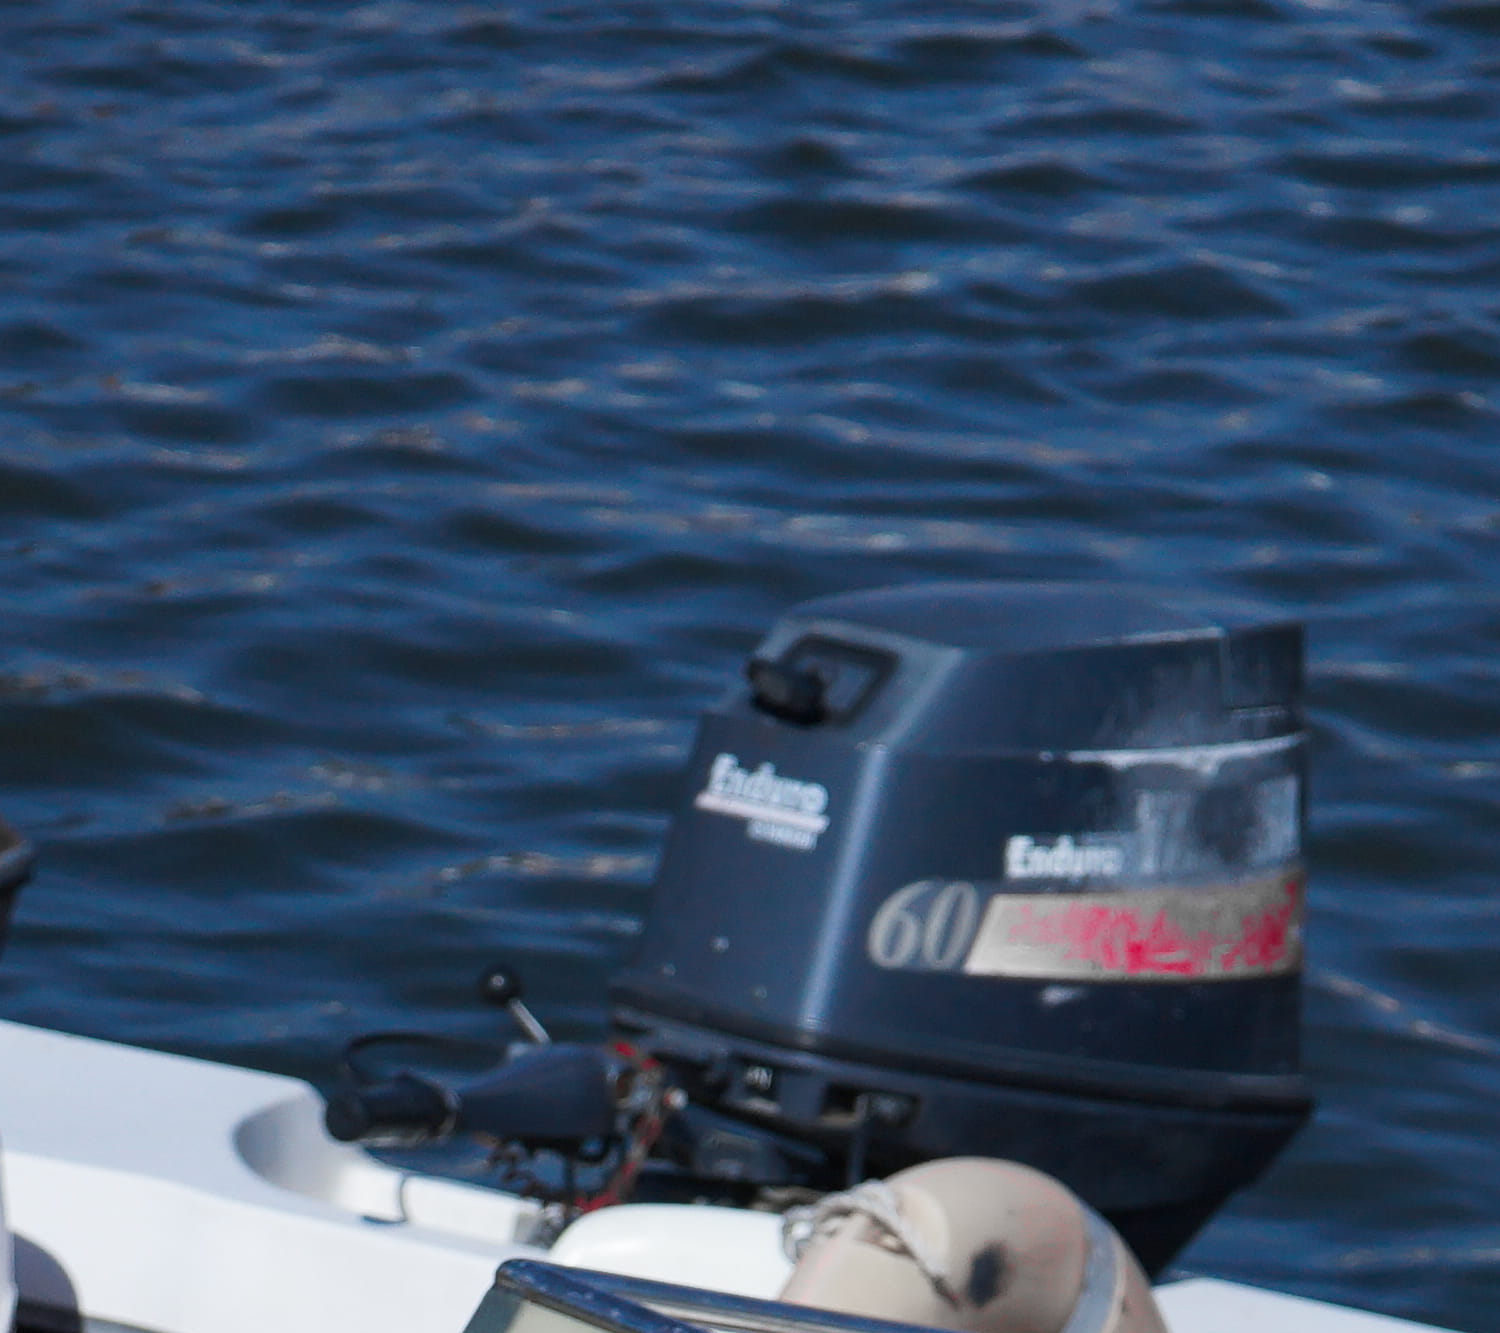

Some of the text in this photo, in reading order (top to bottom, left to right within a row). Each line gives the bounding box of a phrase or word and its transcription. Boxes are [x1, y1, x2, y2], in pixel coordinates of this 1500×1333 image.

[707, 753, 828, 814] Enduro
[1004, 833, 1124, 880] Enduro
[866, 879, 980, 970] 60
